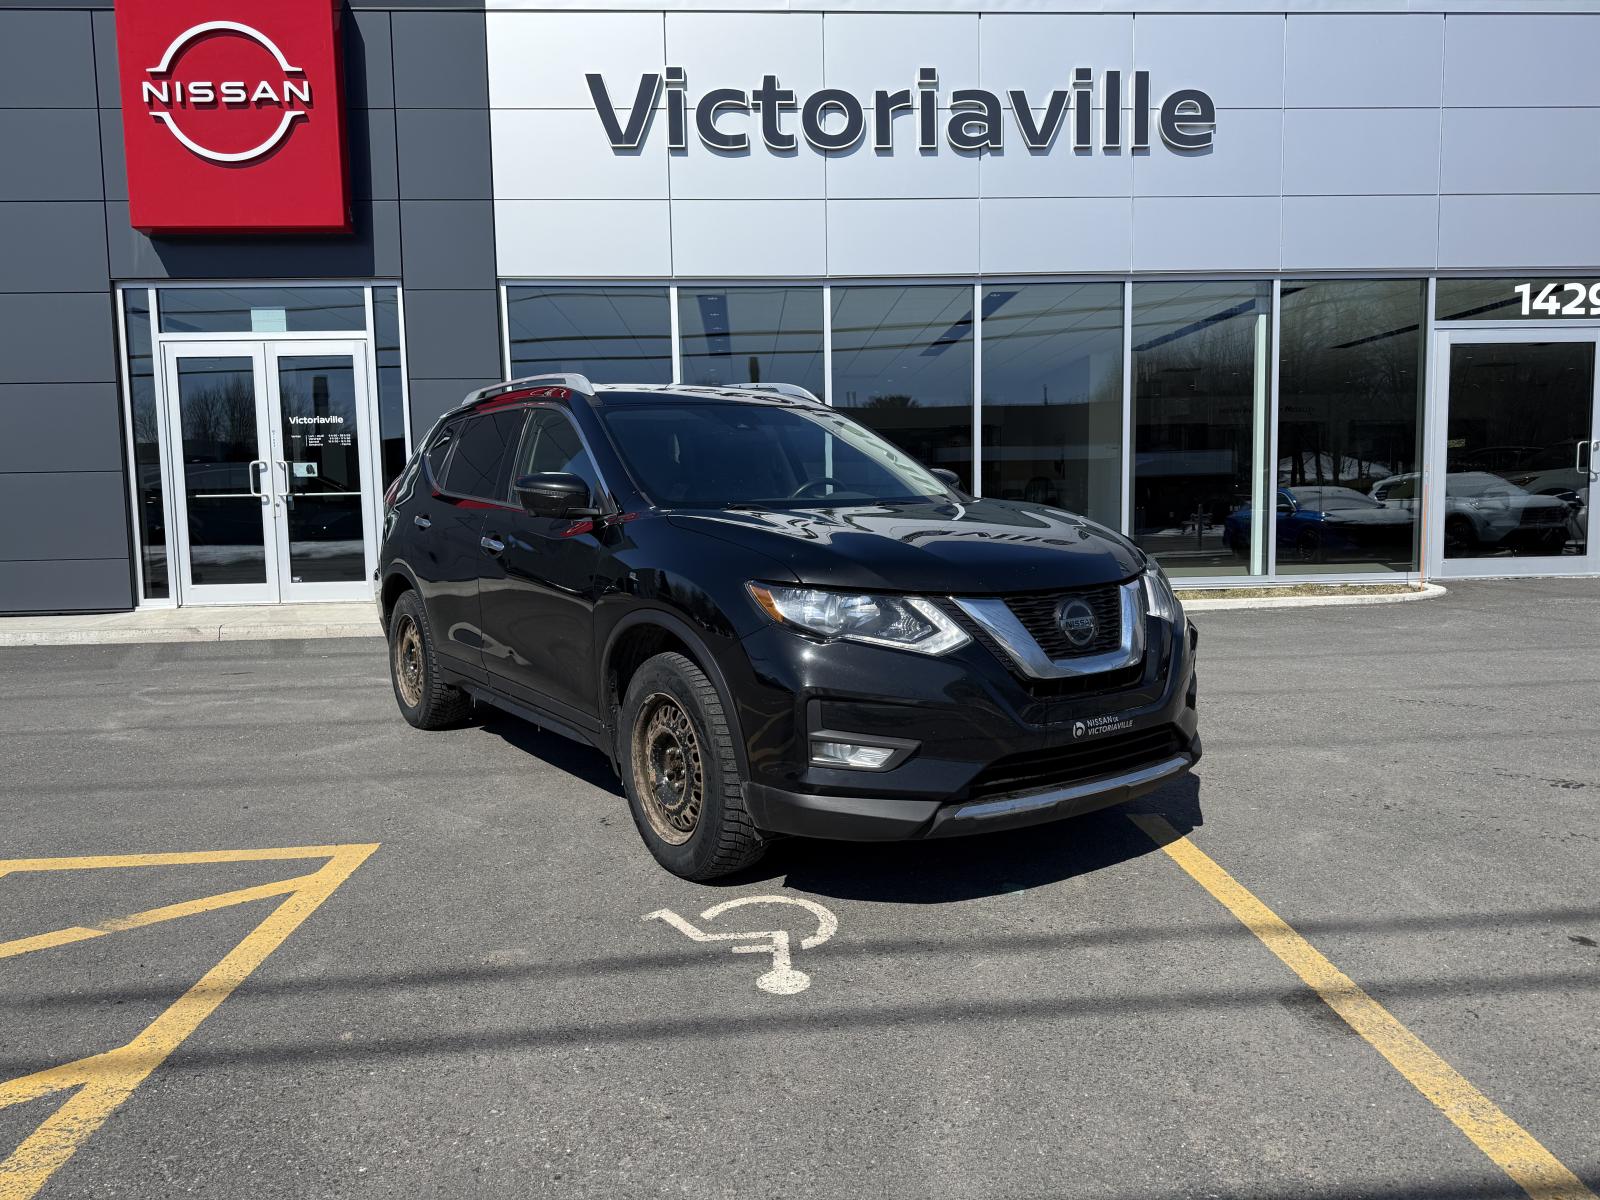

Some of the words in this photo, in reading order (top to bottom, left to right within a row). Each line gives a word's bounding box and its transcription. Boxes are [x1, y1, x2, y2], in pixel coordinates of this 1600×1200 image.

[141, 80, 310, 103] NISSAN
[585, 67, 1217, 156] Victoriaville
[289, 416, 344, 424] Victoriaville
[1087, 716, 1112, 727] NISSAN
[1088, 720, 1133, 735] VICTORIAVILLE
